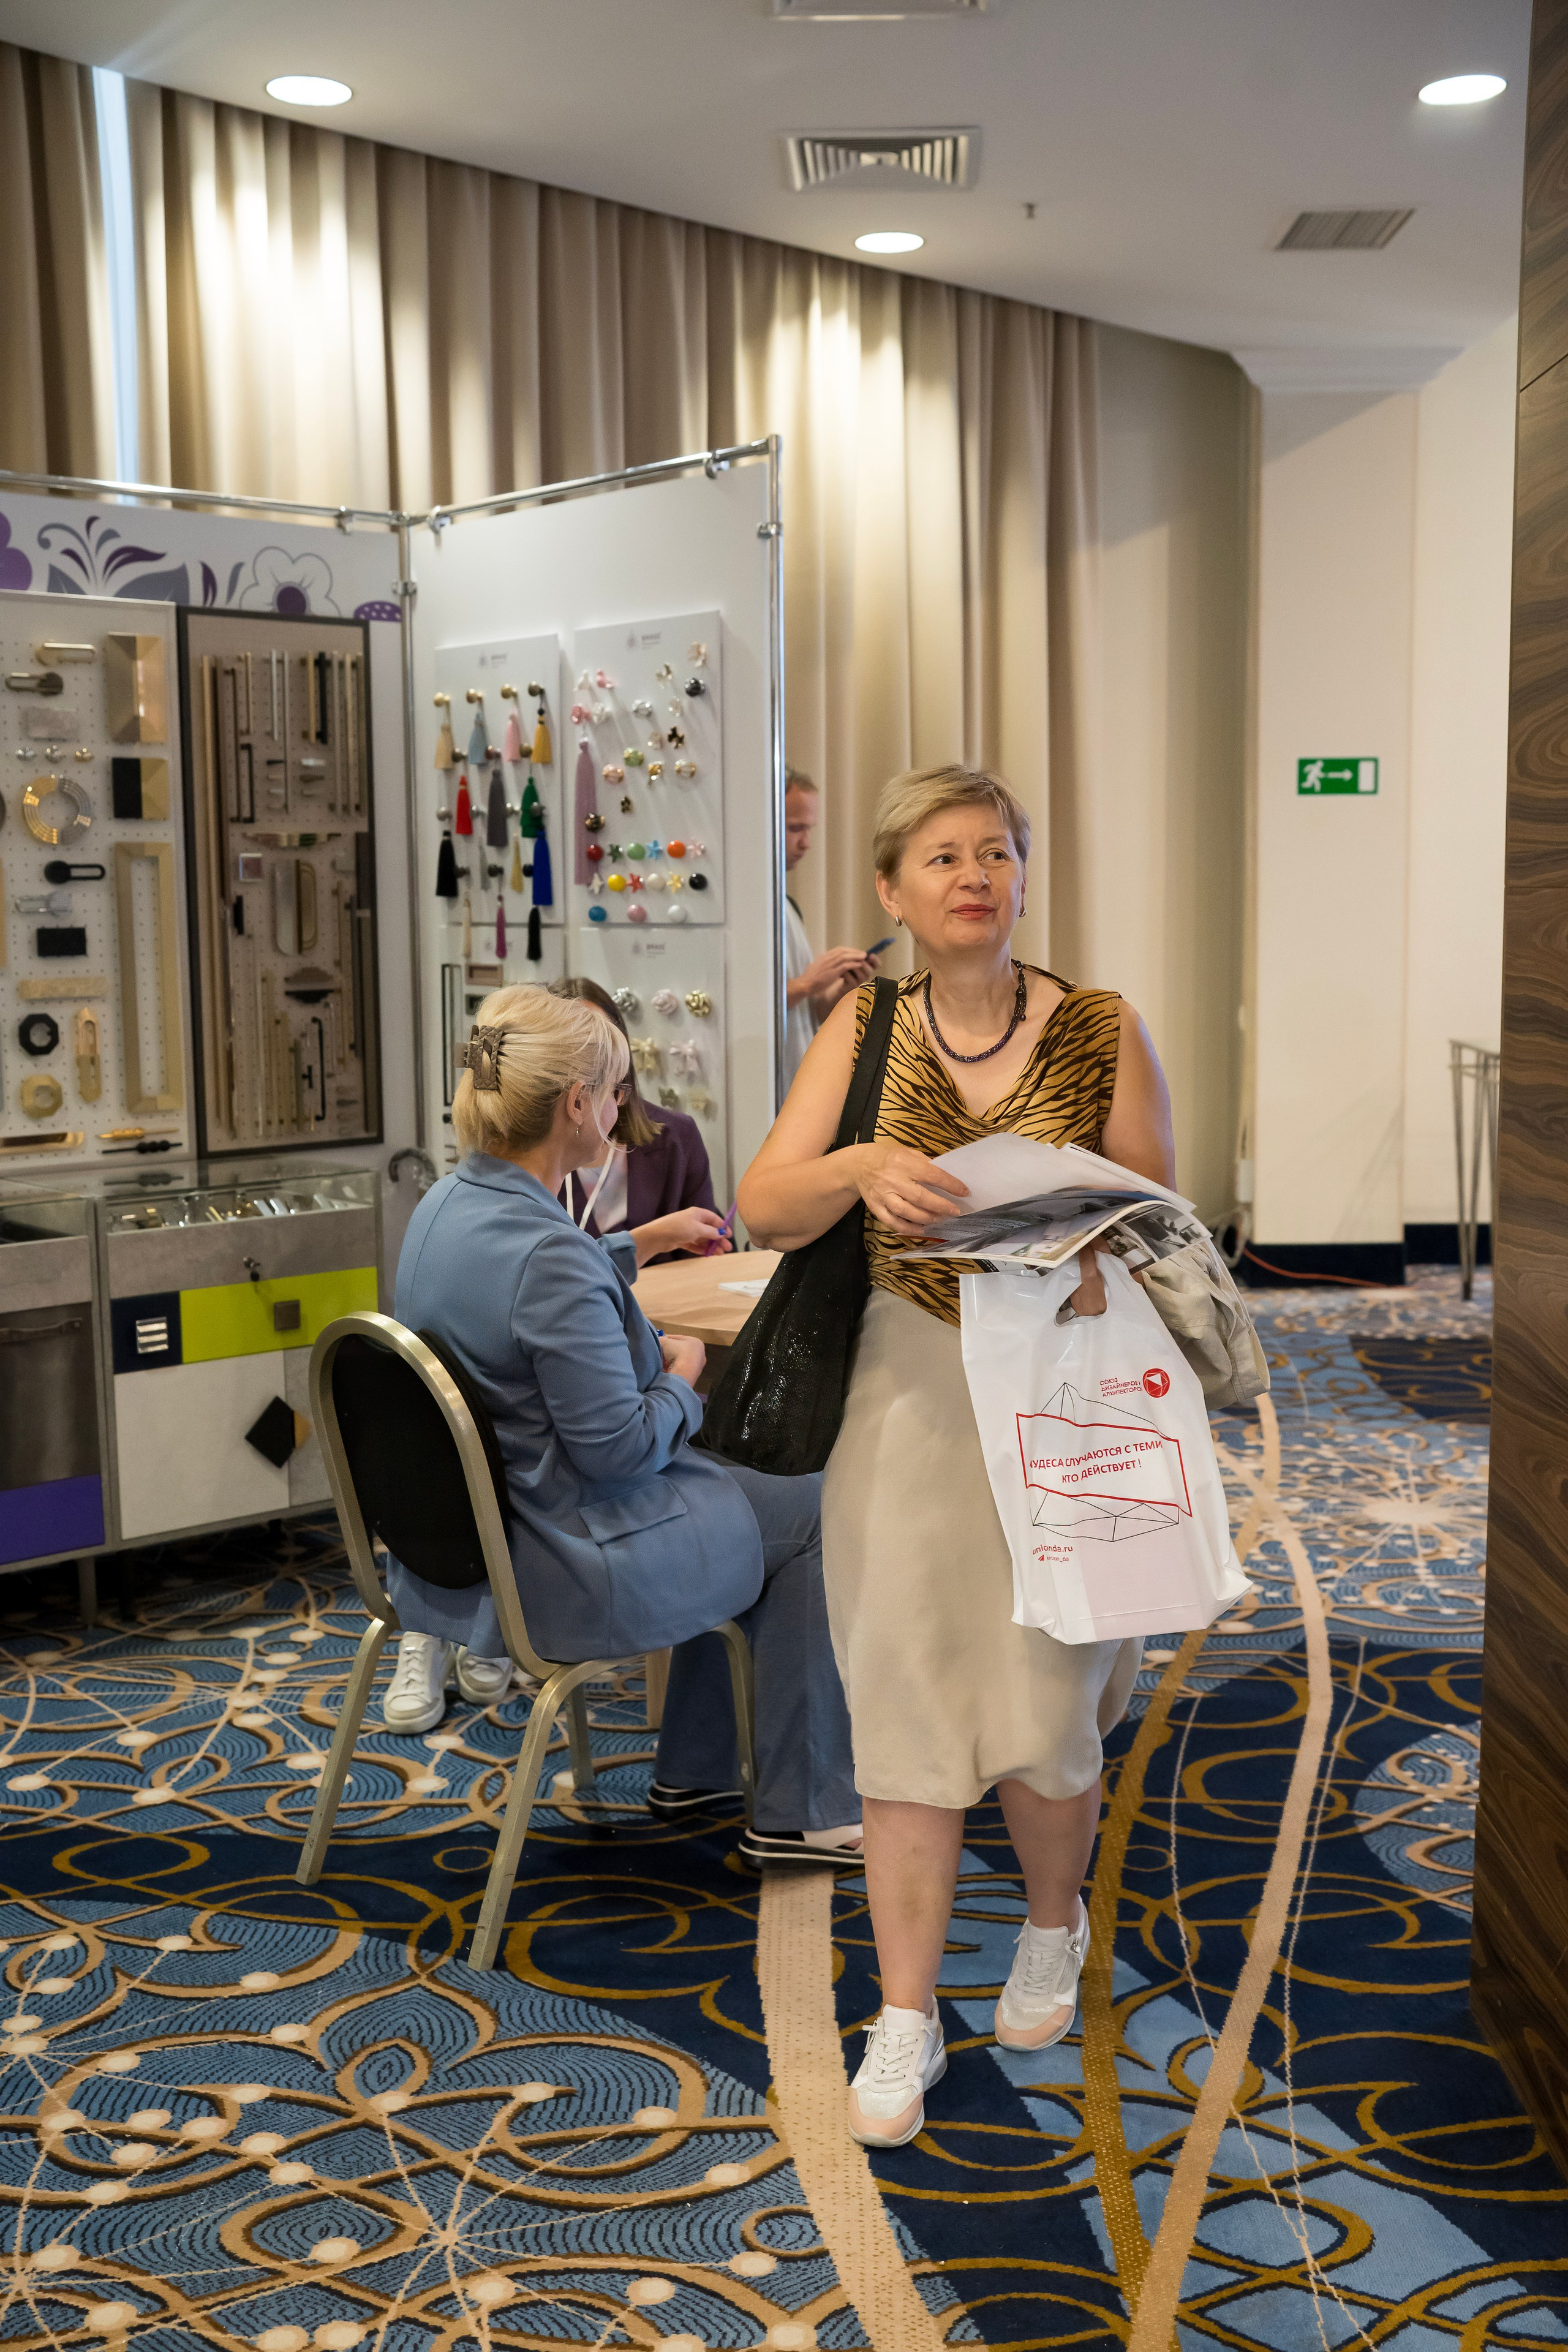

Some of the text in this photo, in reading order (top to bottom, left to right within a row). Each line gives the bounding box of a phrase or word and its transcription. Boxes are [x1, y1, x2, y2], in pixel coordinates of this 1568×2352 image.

[1065, 1446, 1122, 1466] СЛУЧАЮТСЯ
[1125, 1445, 1131, 1453] С
[1061, 1474, 1079, 1483] КТО
[1032, 1544, 1073, 1555] unionda.ru
